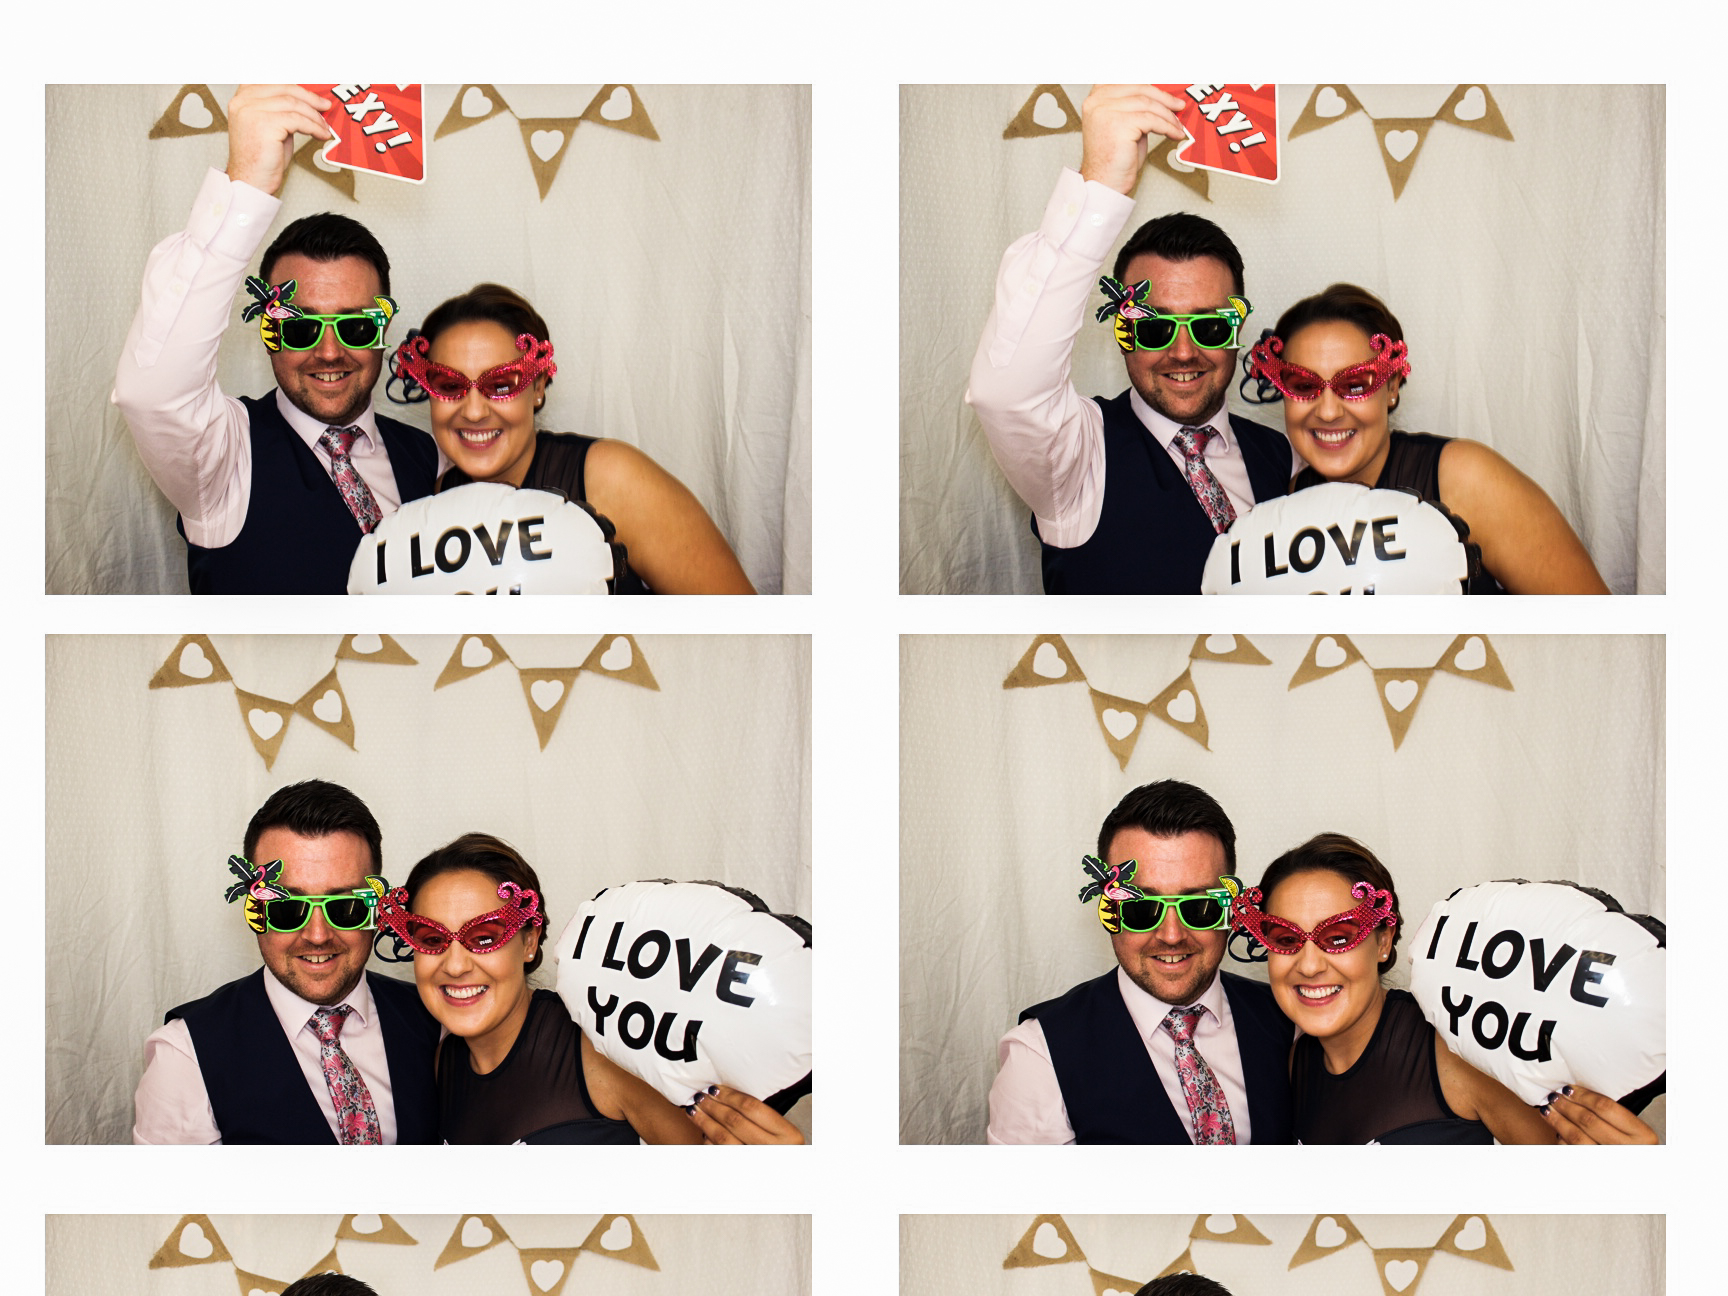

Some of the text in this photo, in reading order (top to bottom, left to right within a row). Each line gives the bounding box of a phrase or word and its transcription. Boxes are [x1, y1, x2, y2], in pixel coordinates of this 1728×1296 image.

[376, 515, 553, 585] I LOVE
[1230, 515, 1407, 585] I LOVE
[572, 915, 763, 1008] I LOVE
[1426, 915, 1617, 1008] I LOVE
[588, 986, 704, 1063] YOU
[1442, 986, 1558, 1063] YOU
